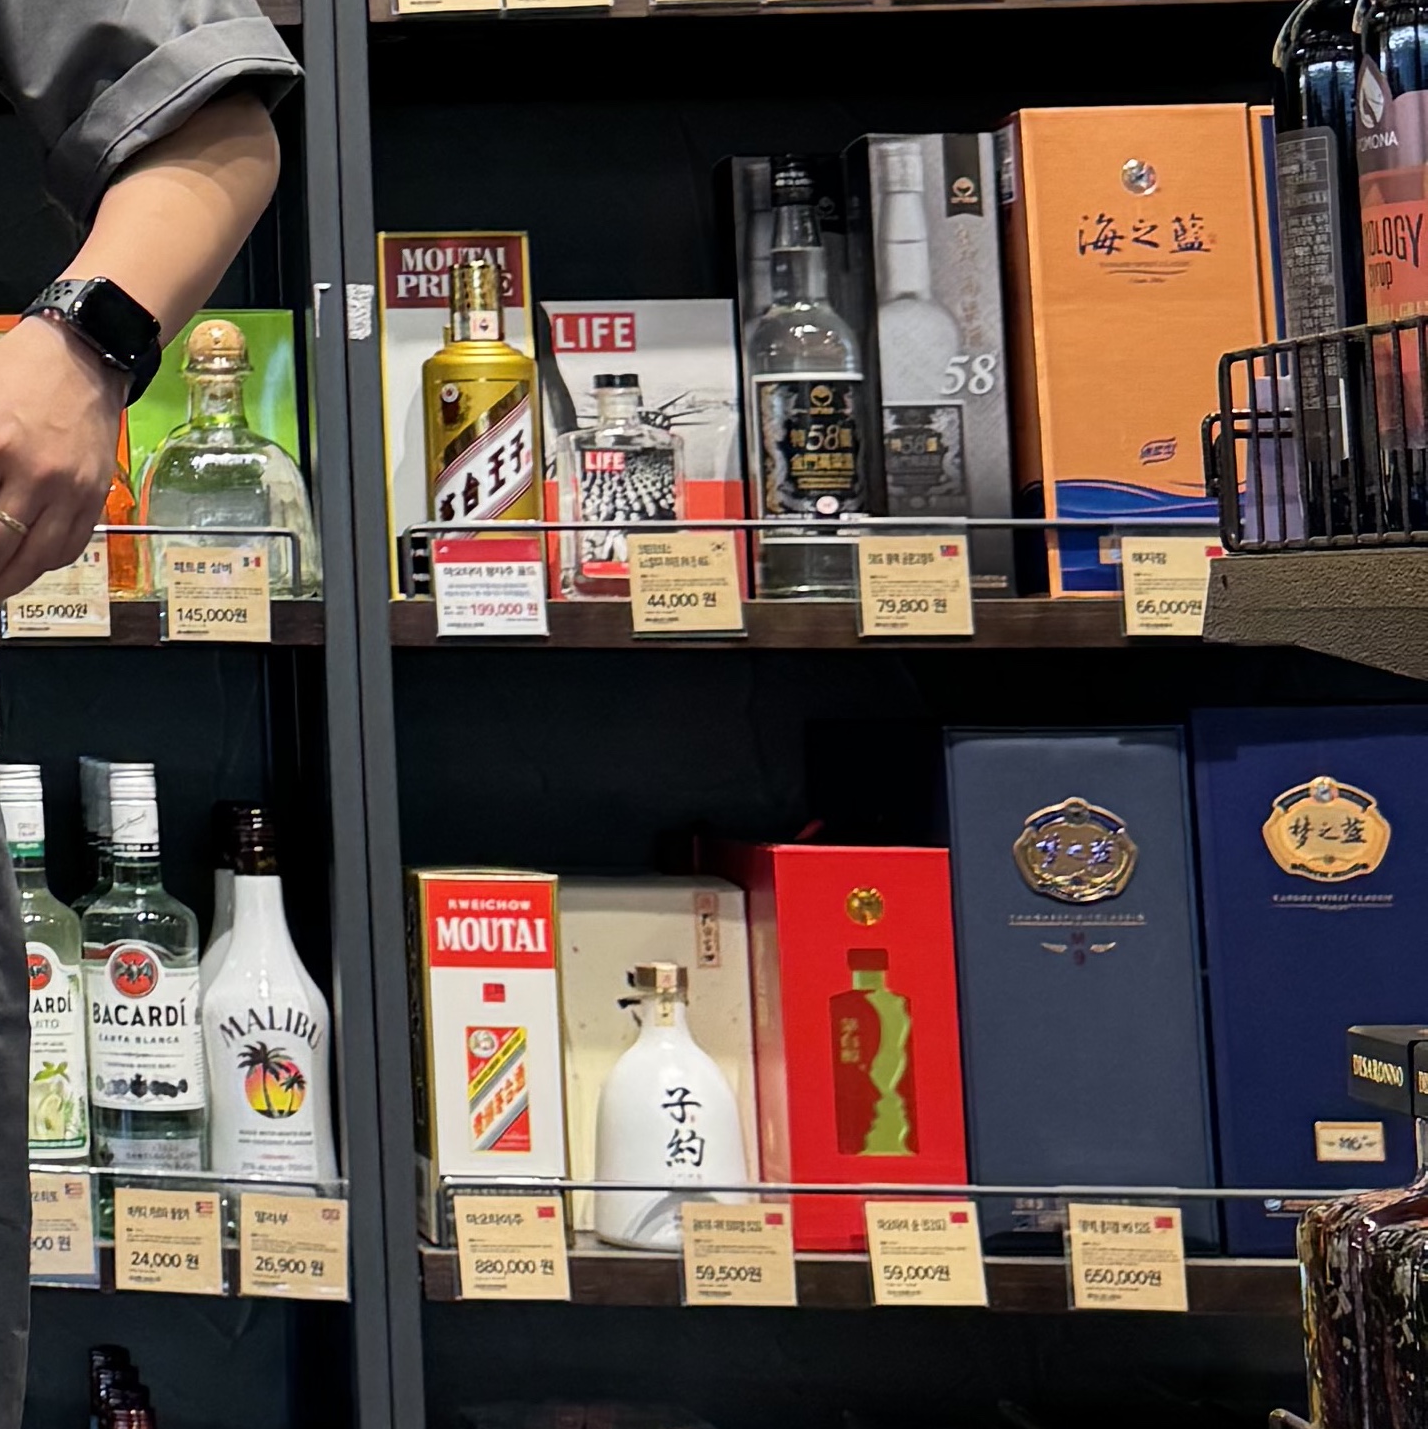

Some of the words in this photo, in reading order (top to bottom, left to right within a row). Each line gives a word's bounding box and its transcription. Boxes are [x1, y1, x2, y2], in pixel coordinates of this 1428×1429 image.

[554, 316, 634, 349] LIFE
[942, 352, 998, 397] 58
[584, 451, 626, 472] LIFE
[175, 607, 248, 624] 145,000원
[646, 592, 699, 610] 44,000
[434, 916, 548, 954] MOUTAI
[91, 990, 189, 1028] BACARDÍ
[220, 1005, 323, 1052] MALIBU
[1351, 1052, 1405, 1089] DISARONNO
[130, 1251, 181, 1270] 24,000
[184, 1251, 200, 1270] 원
[254, 1256, 307, 1274] 26,900
[309, 1258, 325, 1276] 원
